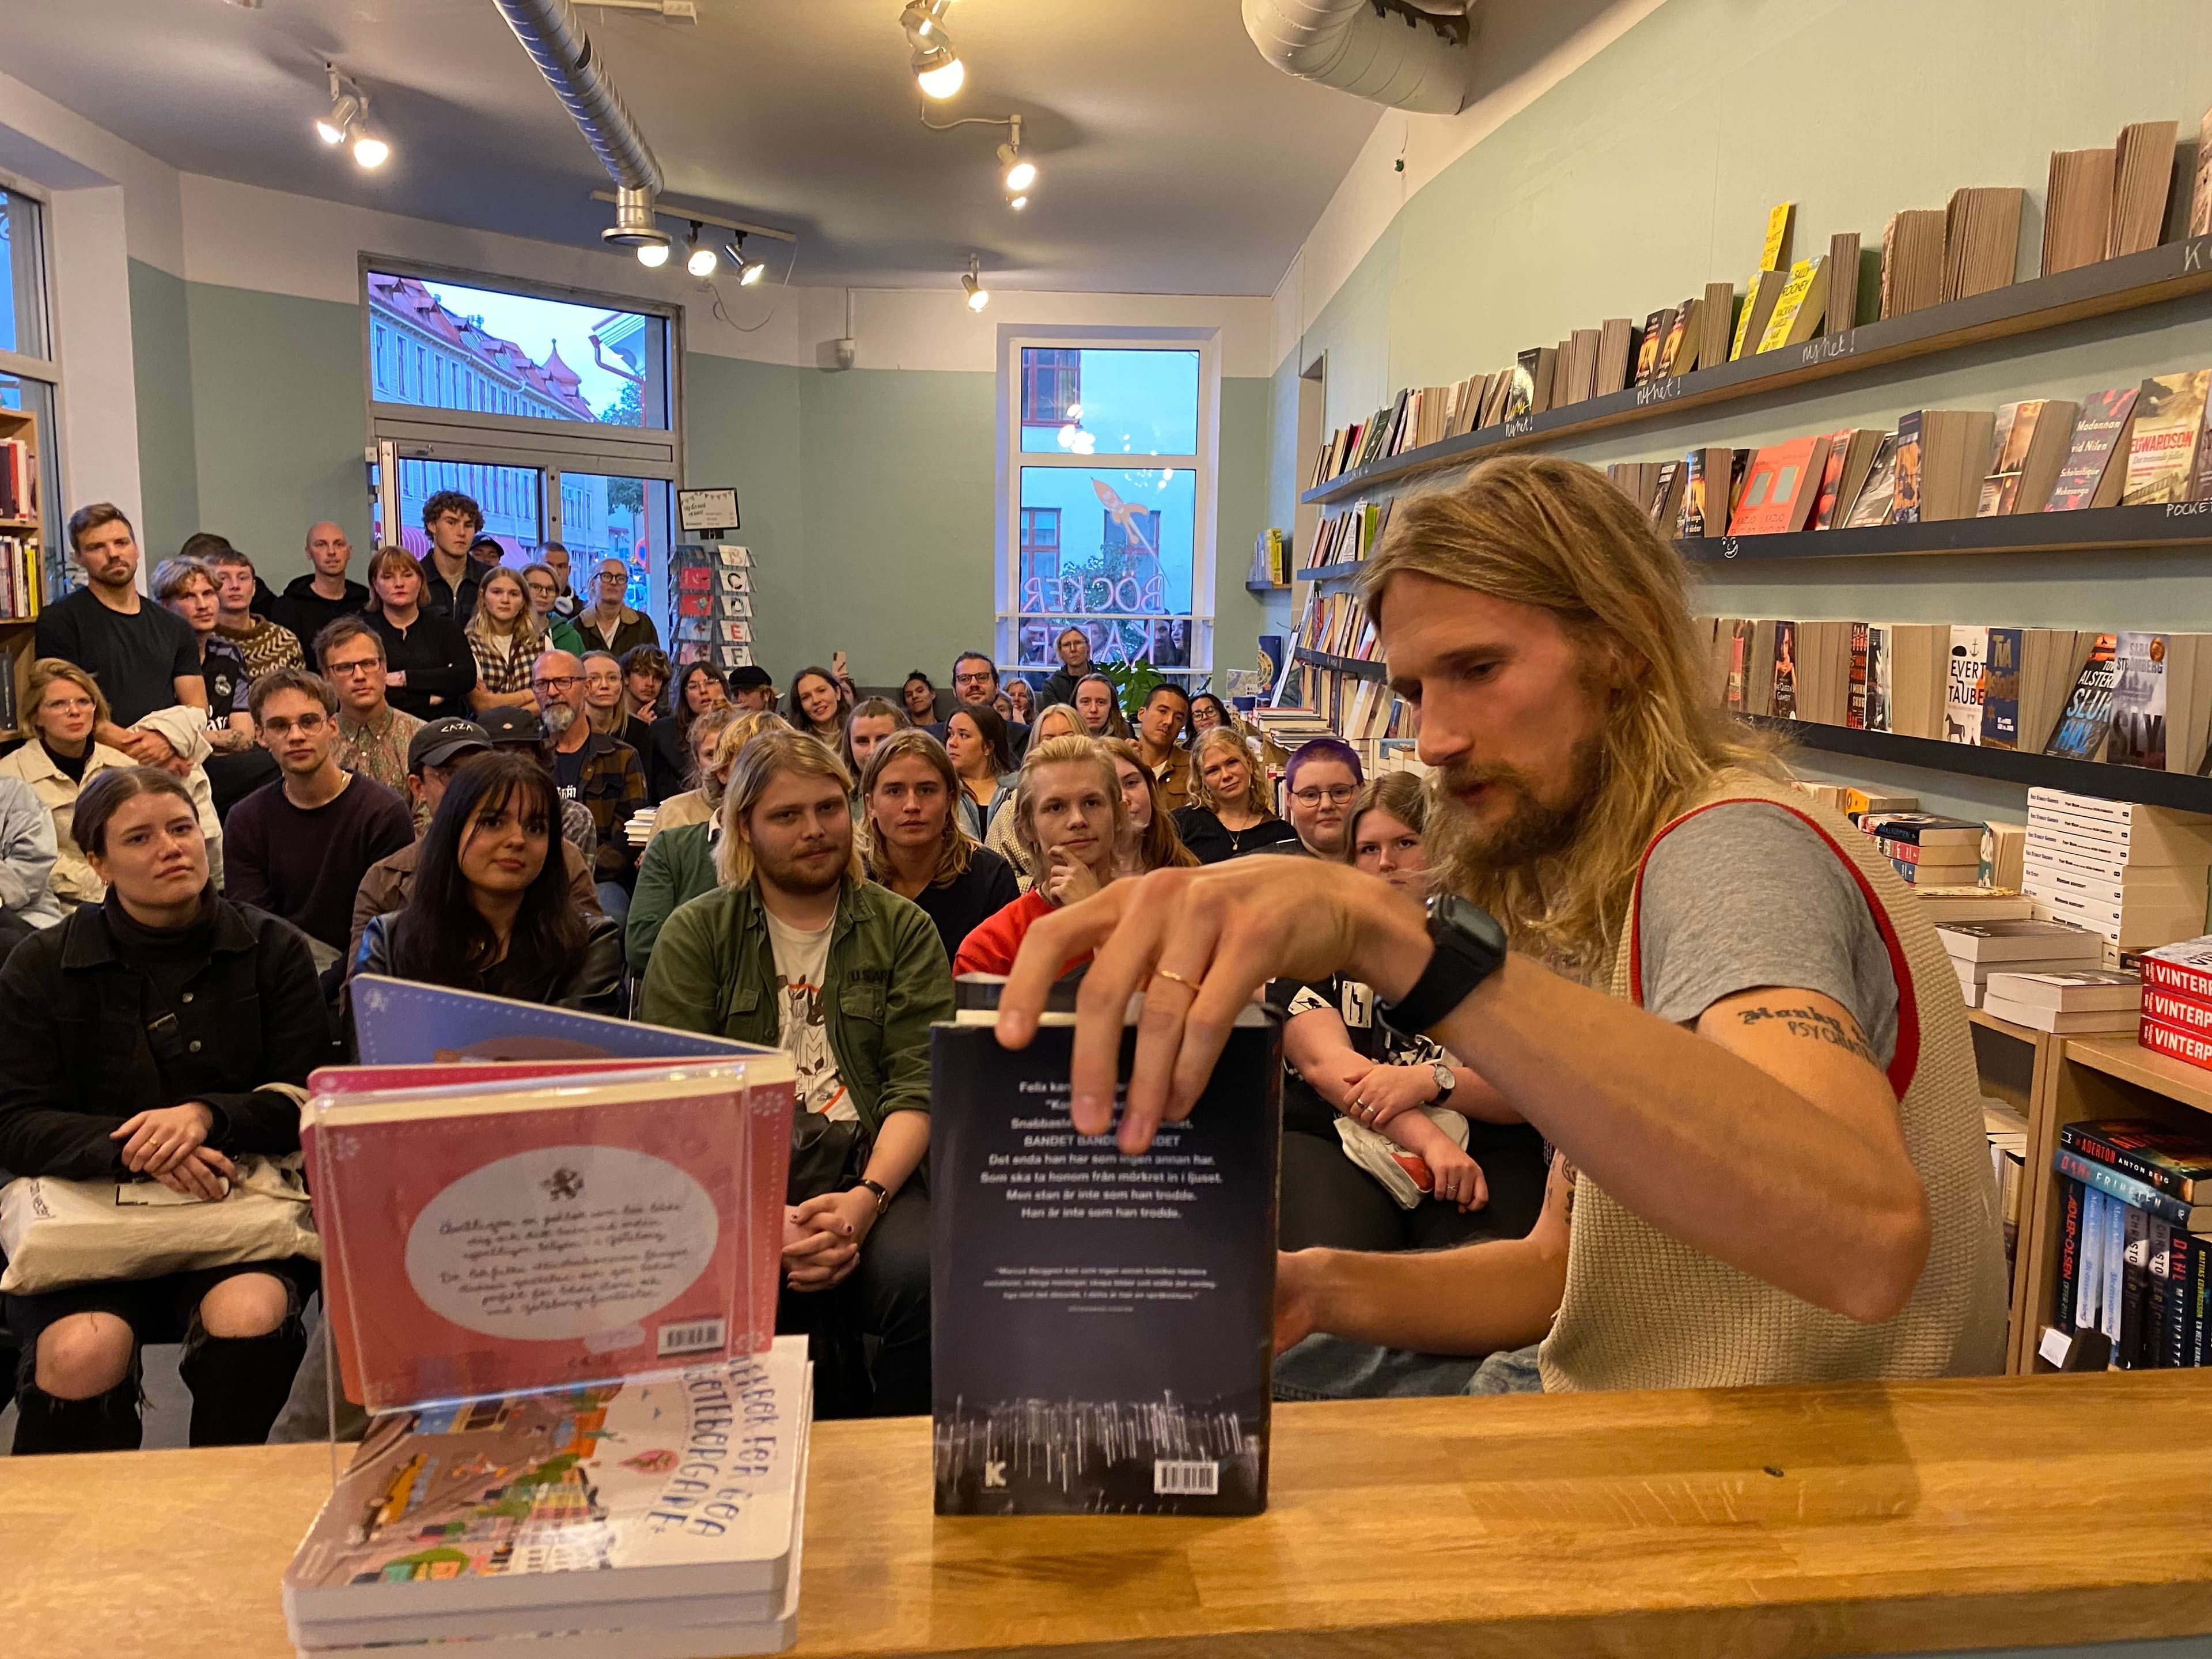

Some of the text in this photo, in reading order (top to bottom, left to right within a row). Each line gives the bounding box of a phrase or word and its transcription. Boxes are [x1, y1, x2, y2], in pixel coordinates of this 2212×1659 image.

[2184, 242, 2212, 271] K
[2076, 419, 2121, 431] Madonnan
[2071, 440, 2107, 453] vid Nilen
[2166, 502, 2212, 518] POCKE
[731, 624, 743, 640] E
[1950, 660, 1986, 679] EVERT
[1949, 685, 1984, 706] TAUBE
[1024, 1135, 1074, 1147] BANDET
[988, 1153, 1009, 1166] Det
[1012, 1153, 1042, 1165] enda
[1044, 1153, 1066, 1165] han
[1069, 1153, 1089, 1165] har
[1091, 1155, 1116, 1165] som
[1155, 1155, 1191, 1165] annan
[2118, 1157, 2145, 1173] ANTON
[980, 1171, 1007, 1184] Som
[1010, 1172, 1031, 1183] ska
[1034, 1172, 1046, 1183] ta
[1048, 1171, 1090, 1183] honom
[1092, 1171, 1115, 1183] från
[1118, 1171, 1164, 1183] mörkret
[1167, 1172, 1179, 1183] in
[1006, 1189, 1198, 1202] Men stan är inte som han trodde.
[1021, 1207, 1183, 1219] Han är inte som han trodde.
[2063, 1194, 2078, 1280] ADLER-OLSEN
[2172, 1238, 2188, 1281] DAHL
